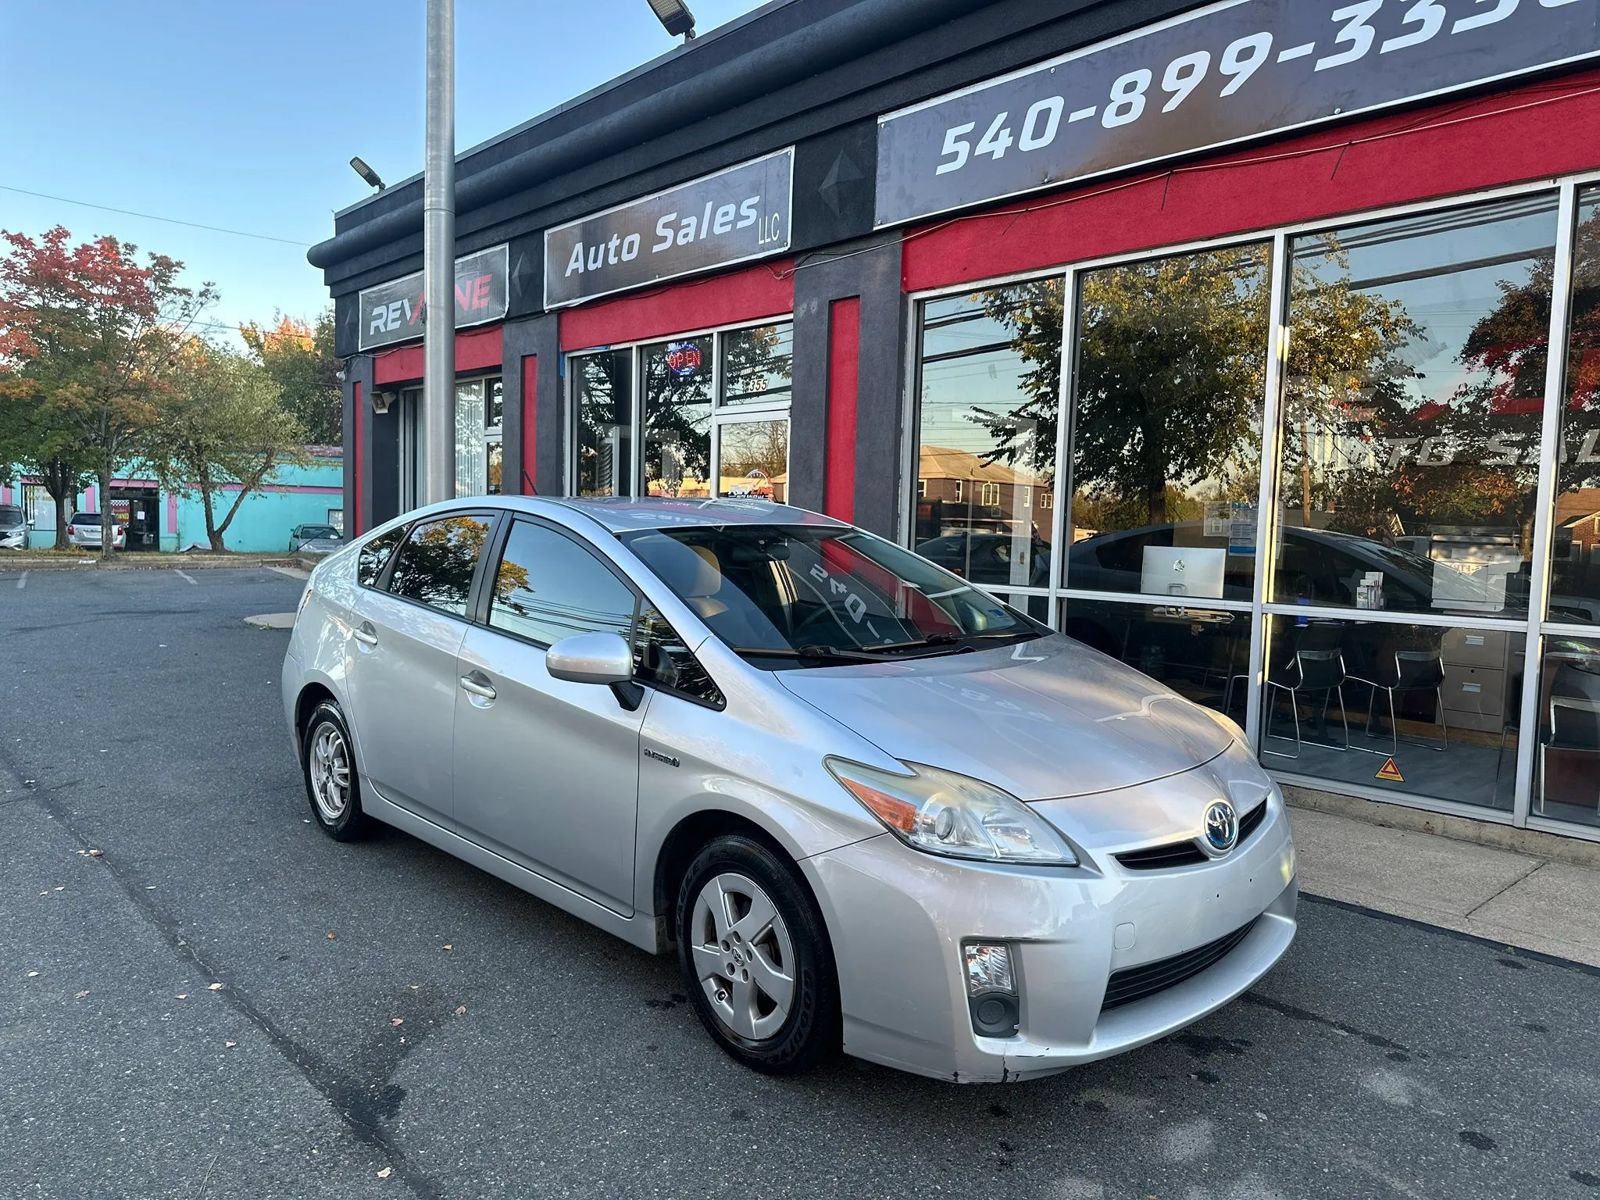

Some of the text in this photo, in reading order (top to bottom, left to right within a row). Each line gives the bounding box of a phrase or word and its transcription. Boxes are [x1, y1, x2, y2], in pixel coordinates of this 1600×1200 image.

[935, 0, 1584, 175] 540-899-33
[565, 195, 760, 277] Auto Sales
[758, 212, 780, 244] LLC
[666, 350, 701, 368] OPEN
[750, 378, 769, 392] 355
